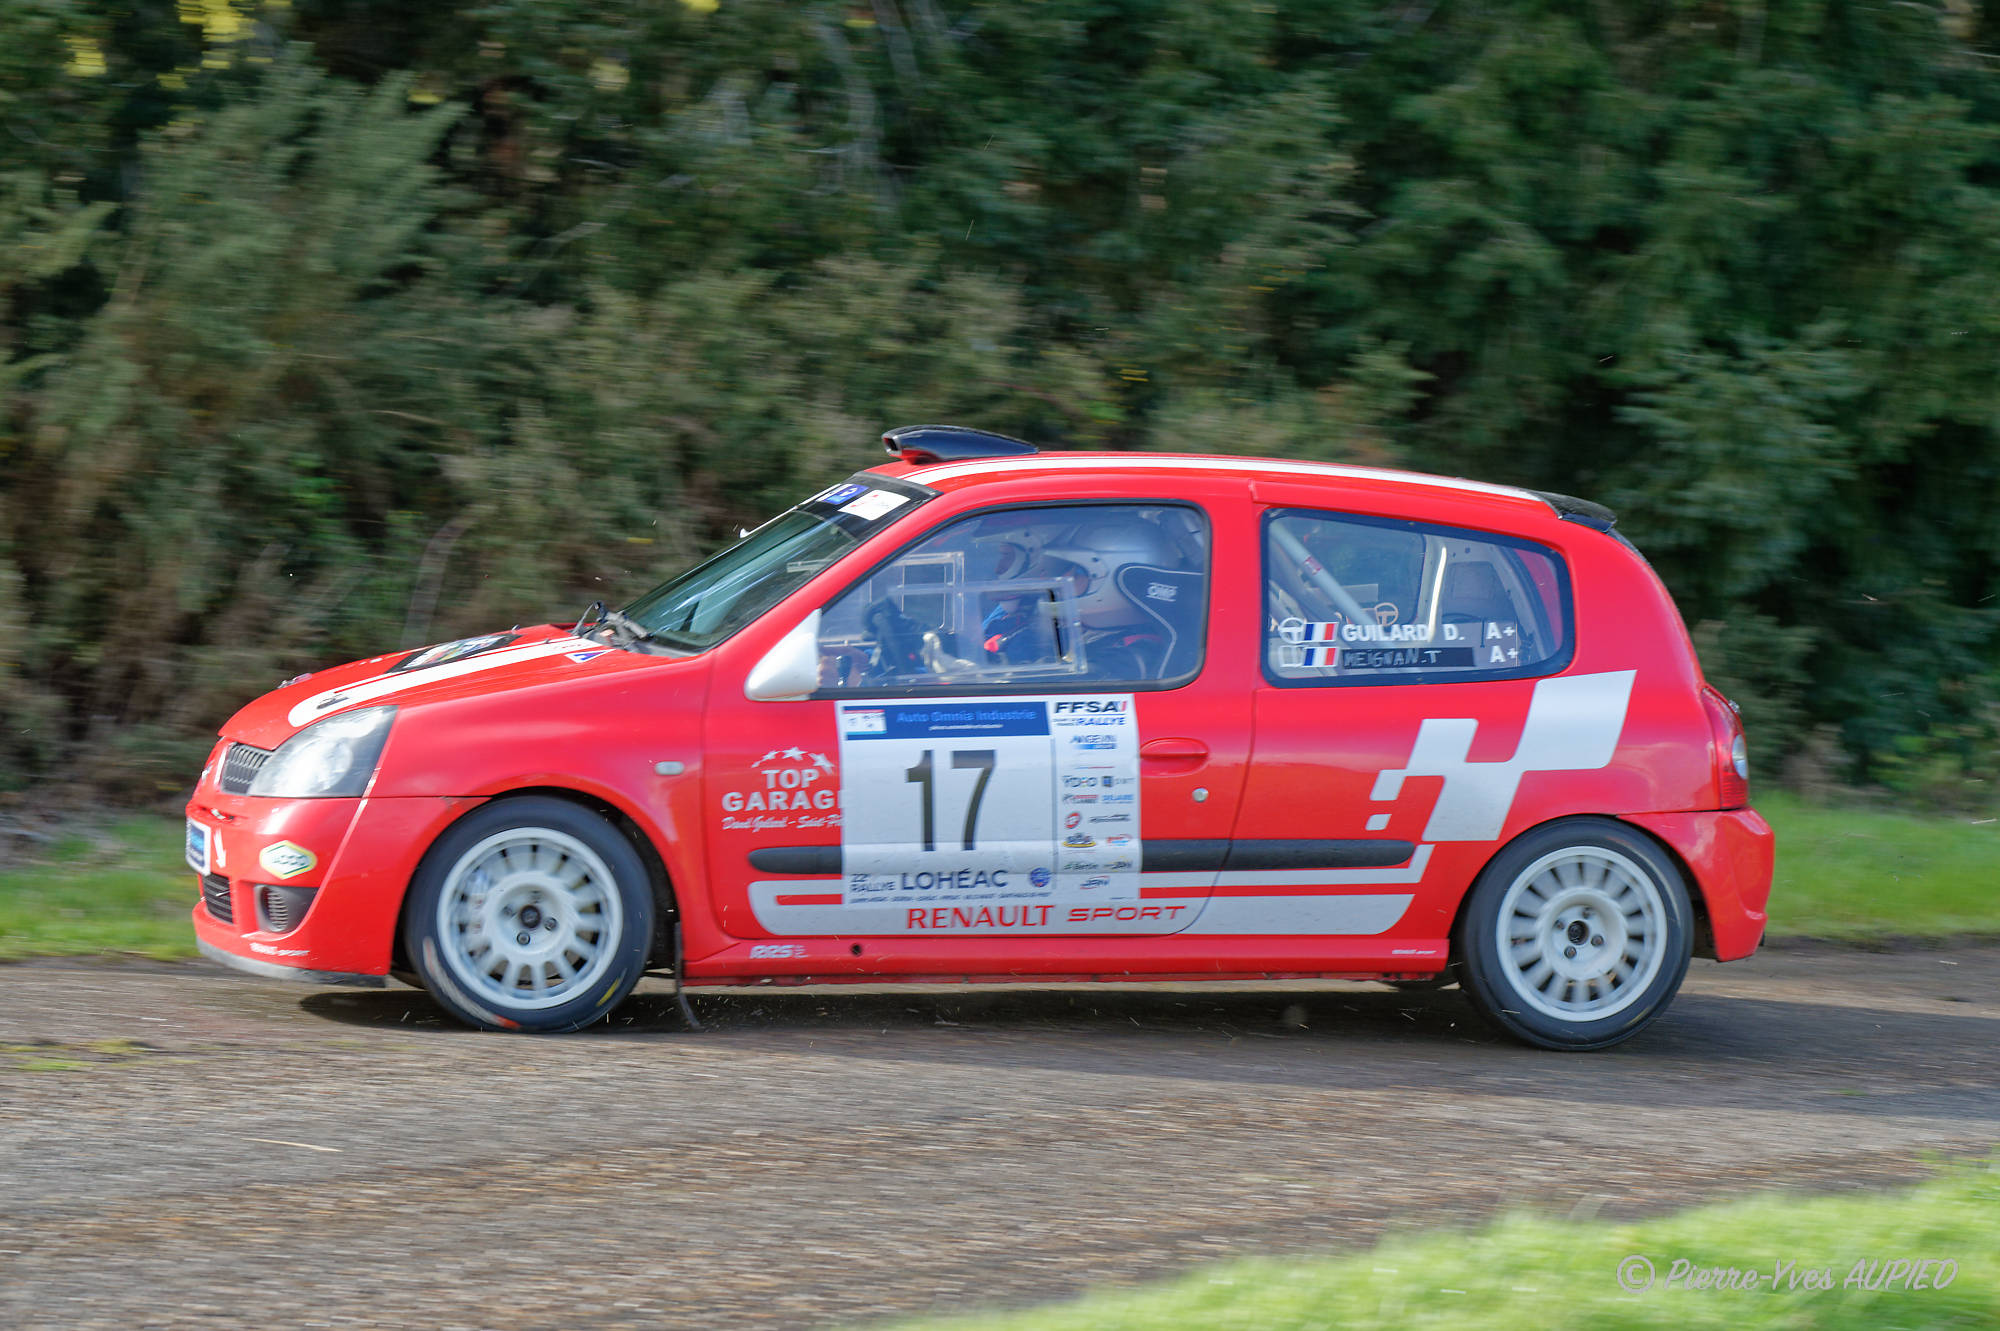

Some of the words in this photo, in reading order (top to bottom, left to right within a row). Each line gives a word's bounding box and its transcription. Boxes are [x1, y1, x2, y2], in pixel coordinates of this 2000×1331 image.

[1341, 623, 1429, 642] GUILARD
[1443, 623, 1465, 641] D.
[1486, 622, 1516, 640] A+
[1490, 645, 1519, 664] A+
[896, 711, 929, 723] Auto
[976, 709, 1037, 721] Industrie
[1055, 700, 1120, 714] FFSA
[761, 768, 820, 789] TOP
[721, 789, 843, 812] GARAG
[904, 749, 997, 852] 17
[850, 882, 896, 893] RALLYE
[901, 867, 1008, 891] LOHÉAC
[907, 904, 1055, 930] RENAULT
[1066, 905, 1188, 923] SPORT
